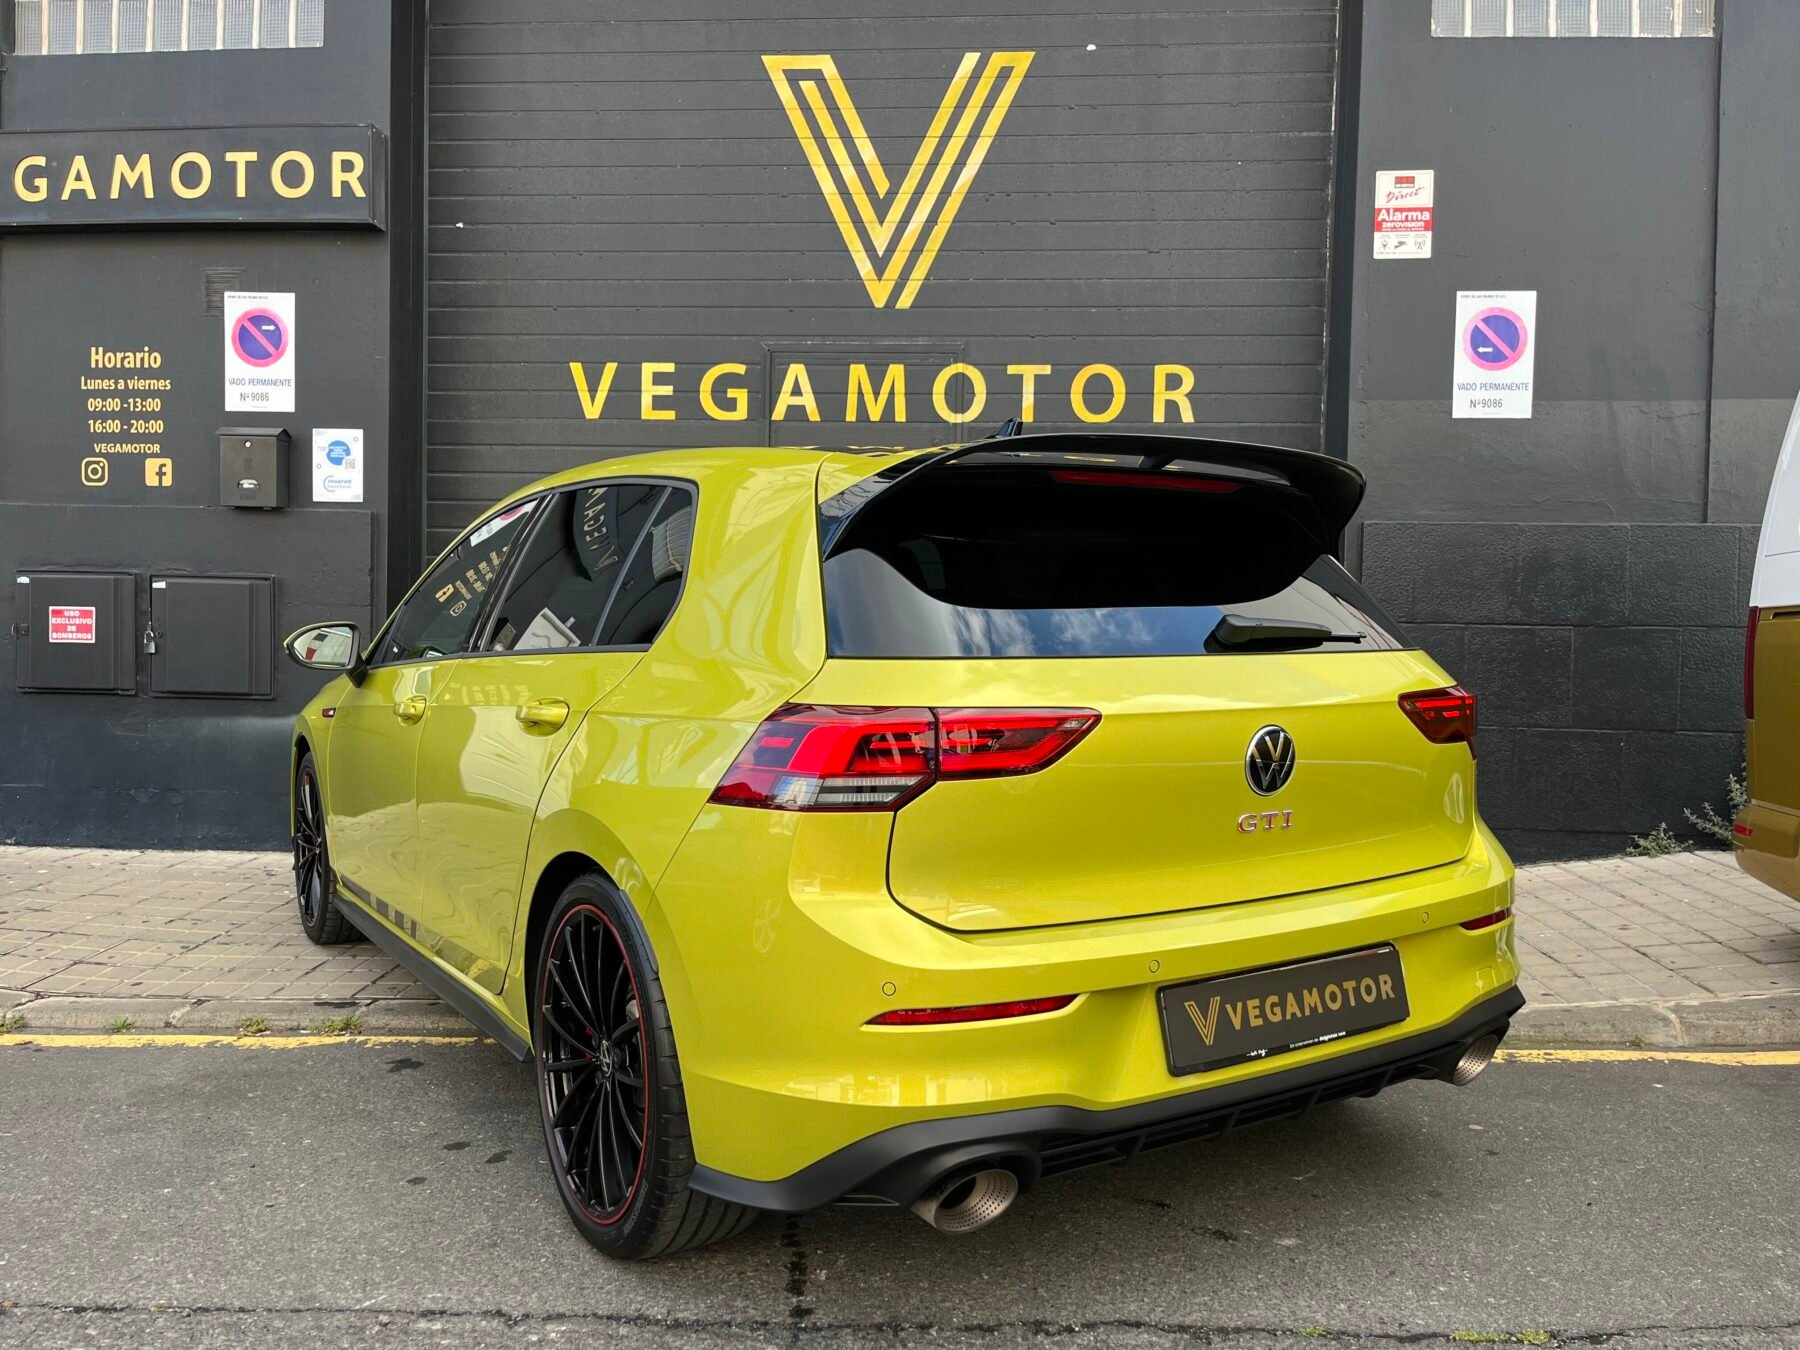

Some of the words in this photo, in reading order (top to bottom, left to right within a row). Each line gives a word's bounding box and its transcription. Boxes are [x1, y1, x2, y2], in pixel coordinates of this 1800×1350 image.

[12, 150, 366, 203] GAMOTOR
[1377, 208, 1430, 221] Alarma
[90, 346, 162, 369] Horario
[81, 376, 116, 390] Lunes
[117, 380, 125, 390] a
[127, 376, 171, 391] viernes
[228, 377, 246, 386] VADO
[248, 378, 293, 387] PERMANENTE
[1457, 382, 1478, 391] VADO
[1479, 382, 1530, 391] PERMANENTE
[569, 361, 1196, 425] VEGAMOTOR
[87, 398, 121, 412] 09:00
[88, 419, 121, 433] 16:00
[130, 419, 164, 433] 20:00
[94, 443, 161, 454] VEGAMOTOR
[52, 632, 92, 640] BOMBEROS
[1238, 809, 1293, 833] GTI
[1225, 974, 1395, 1031] VEGAMOTOR
